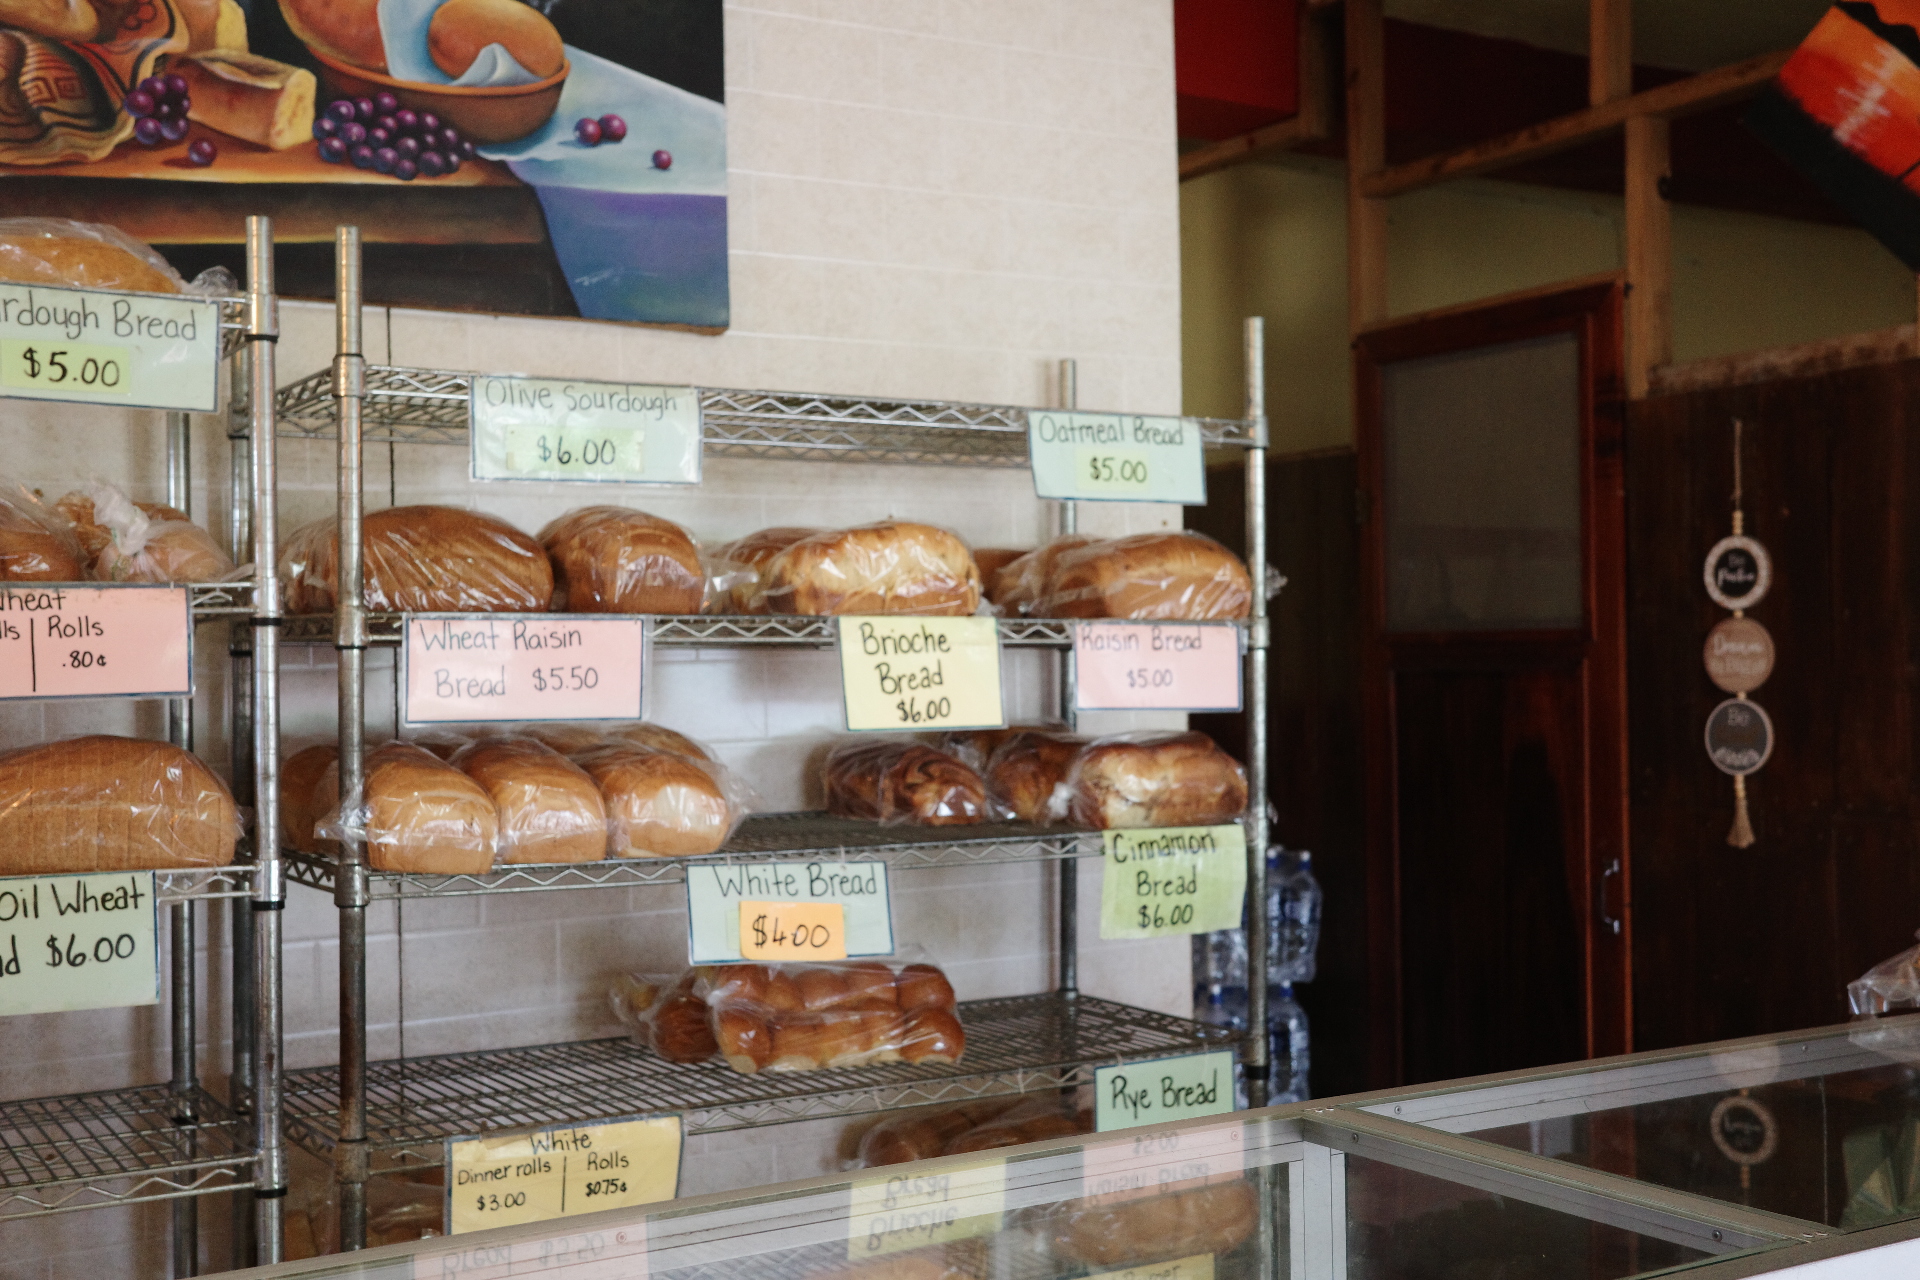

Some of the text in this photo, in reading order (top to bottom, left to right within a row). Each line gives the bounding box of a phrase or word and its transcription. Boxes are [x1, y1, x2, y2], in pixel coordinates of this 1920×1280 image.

[0, 289, 196, 340] rdough Bread
[23, 347, 120, 386] $5.00
[485, 379, 678, 421] Olive Sourdough
[1039, 414, 1184, 446] Oatmeal Bread
[536, 434, 617, 465] $6.00
[1089, 456, 1148, 483] $5.00
[48, 615, 104, 639] Rolls
[419, 620, 582, 651] Wheat Raisin
[859, 622, 951, 655] Brioche
[1081, 626, 1203, 653] Raisin Bread
[434, 665, 599, 698] Bread $5.50
[875, 659, 944, 695] Bread
[1127, 667, 1174, 689] $5.00
[897, 697, 951, 723] $6.00
[1112, 832, 1217, 864] Cinnamon
[712, 863, 878, 898] White Bread
[1136, 864, 1198, 897] Bread
[0, 876, 146, 921] Oil Wheat
[1138, 903, 1195, 929] $6.00
[46, 933, 136, 968] $6.00
[1110, 1067, 1218, 1120] Rye Bread
[529, 1128, 593, 1155] White
[457, 1158, 552, 1186] Dinner rolls
[587, 1151, 630, 1171] Rolls
[476, 1191, 527, 1211] $3.00
